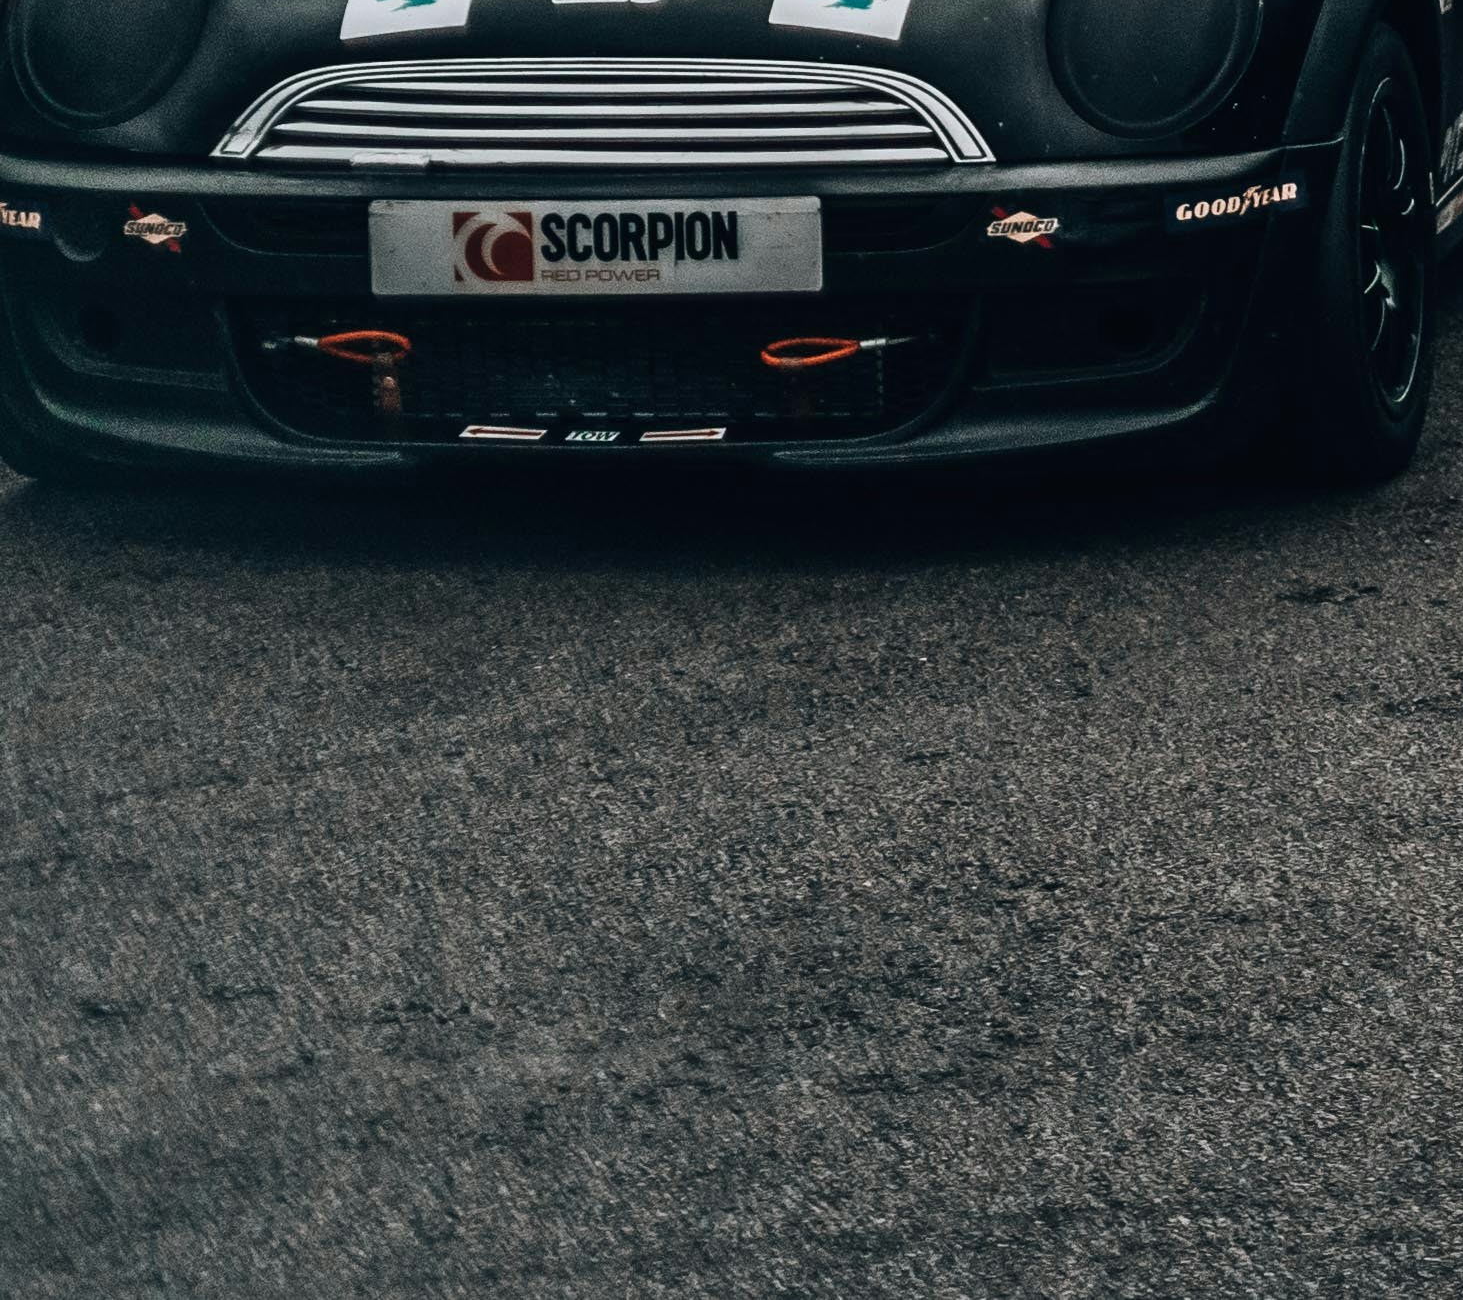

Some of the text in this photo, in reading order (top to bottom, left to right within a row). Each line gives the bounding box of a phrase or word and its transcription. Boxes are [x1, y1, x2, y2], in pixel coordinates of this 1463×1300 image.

[1176, 182, 1298, 222] GOODYEAR
[123, 219, 188, 238] SUNOCO
[986, 217, 1060, 237] SUNOCO
[540, 211, 739, 263] SCORPION
[541, 269, 661, 283] RED POWER
[570, 430, 616, 441] TOW
